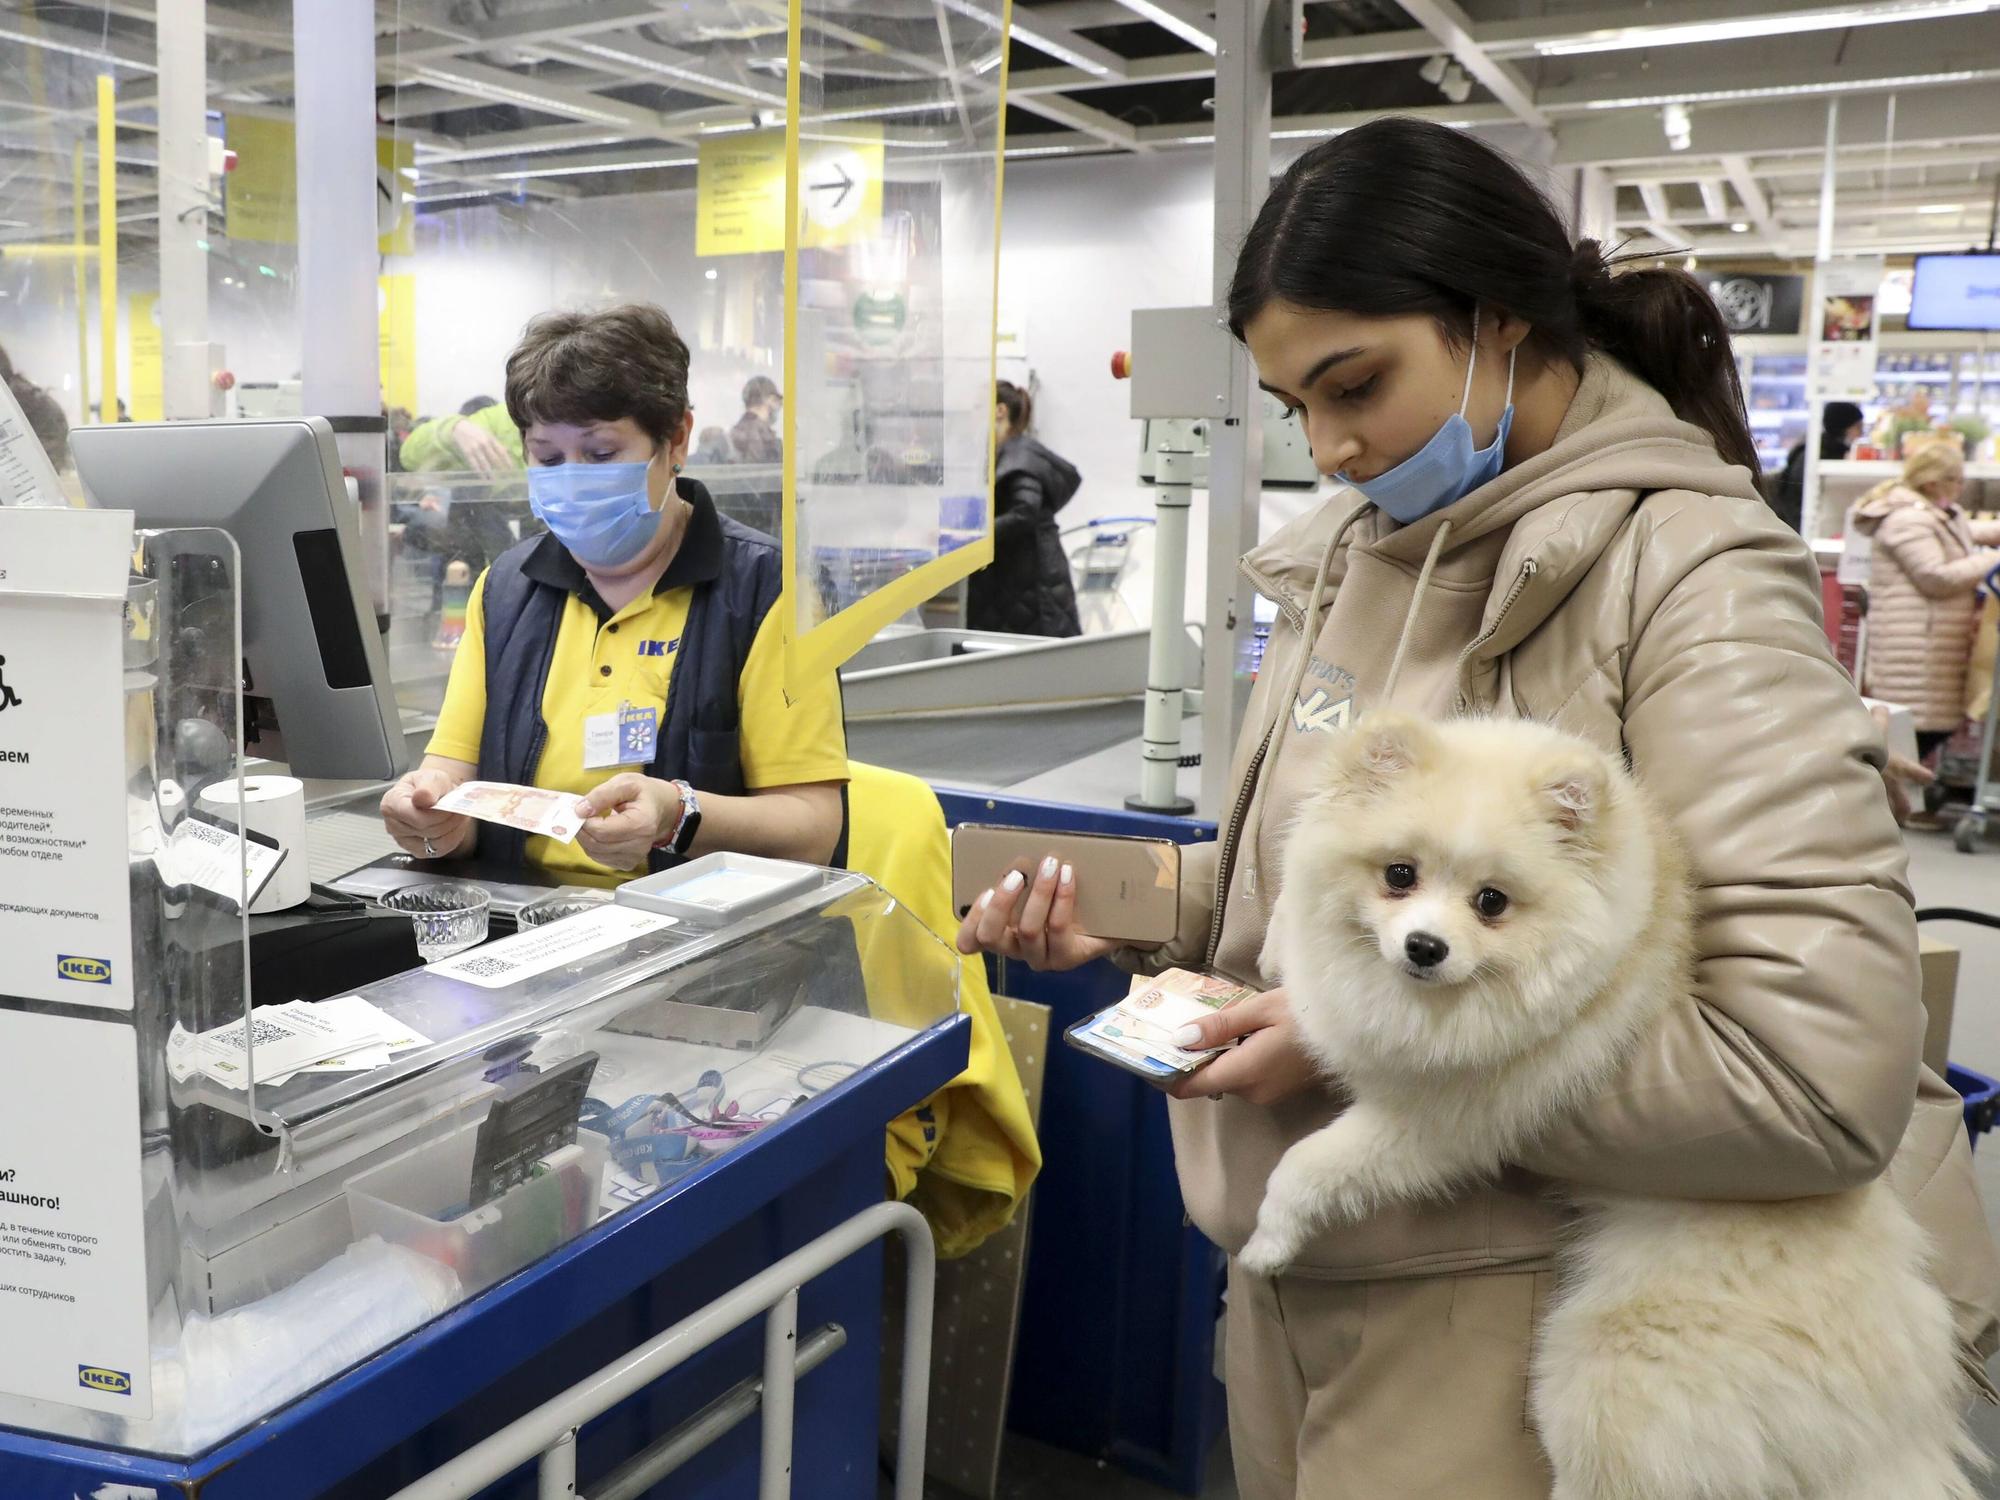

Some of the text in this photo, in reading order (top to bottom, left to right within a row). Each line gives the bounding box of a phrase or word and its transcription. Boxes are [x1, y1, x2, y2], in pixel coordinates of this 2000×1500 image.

[638, 638, 680, 656] IKE
[0, 806, 54, 819] еременных
[31, 851, 63, 861] отделе
[49, 908, 99, 920] документов
[63, 962, 107, 977] IKEA
[10, 1223, 16, 1231] в
[18, 1225, 55, 1238] течение
[56, 1232, 98, 1246] которого
[2, 1234, 91, 1256] или обменять свою
[18, 1286, 76, 1303] сотрудников
[84, 1371, 127, 1388] IKEA
